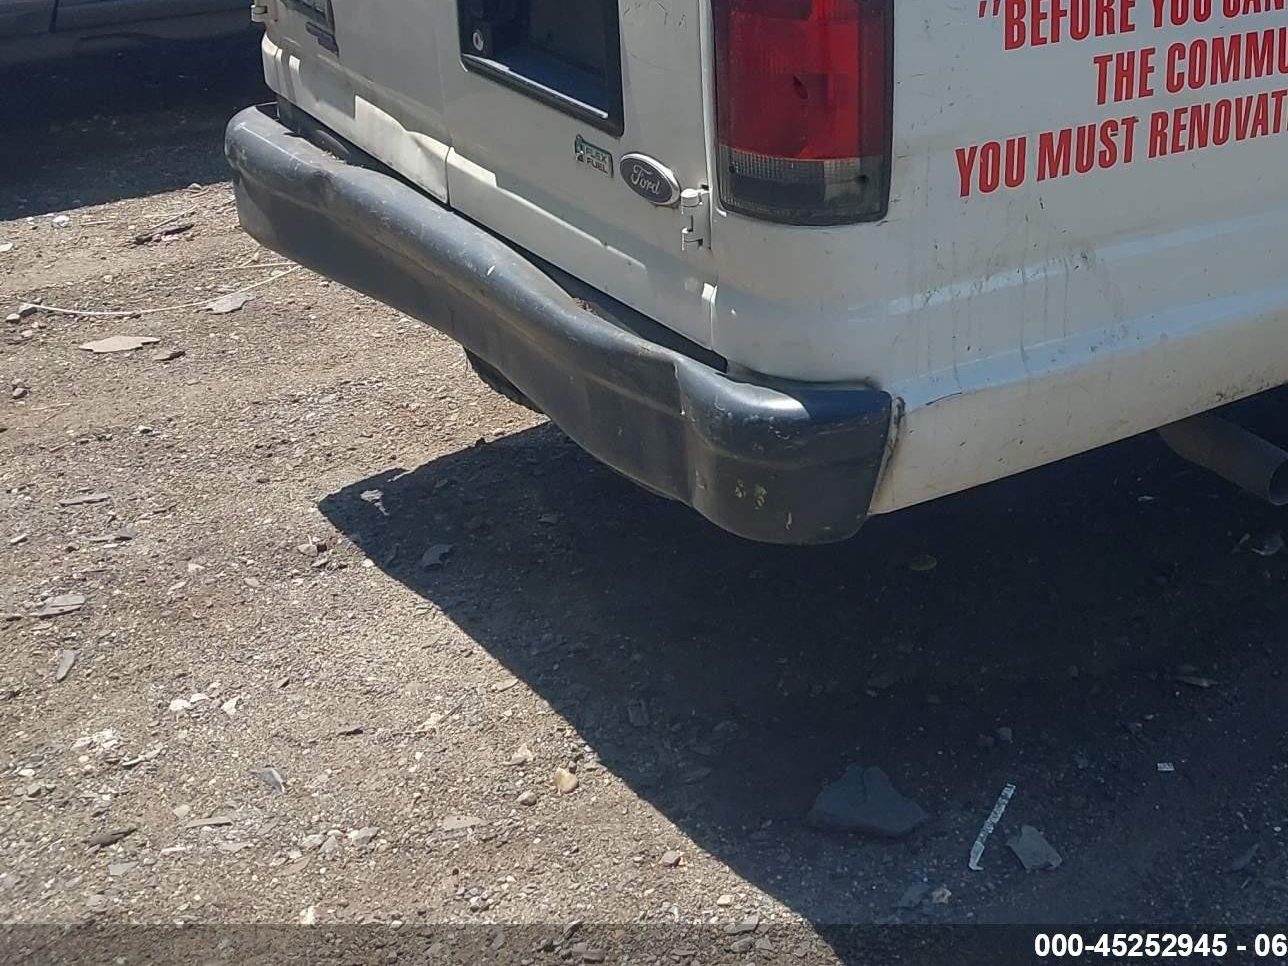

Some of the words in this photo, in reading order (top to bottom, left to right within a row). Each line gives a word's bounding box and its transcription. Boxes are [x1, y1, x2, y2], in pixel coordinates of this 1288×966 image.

[1094, 47, 1155, 105] THE
[584, 144, 608, 163] FLEX
[586, 156, 608, 174] FUEL
[955, 137, 1026, 197] YOU
[1036, 116, 1139, 181] MUST
[631, 164, 660, 195] Ford
